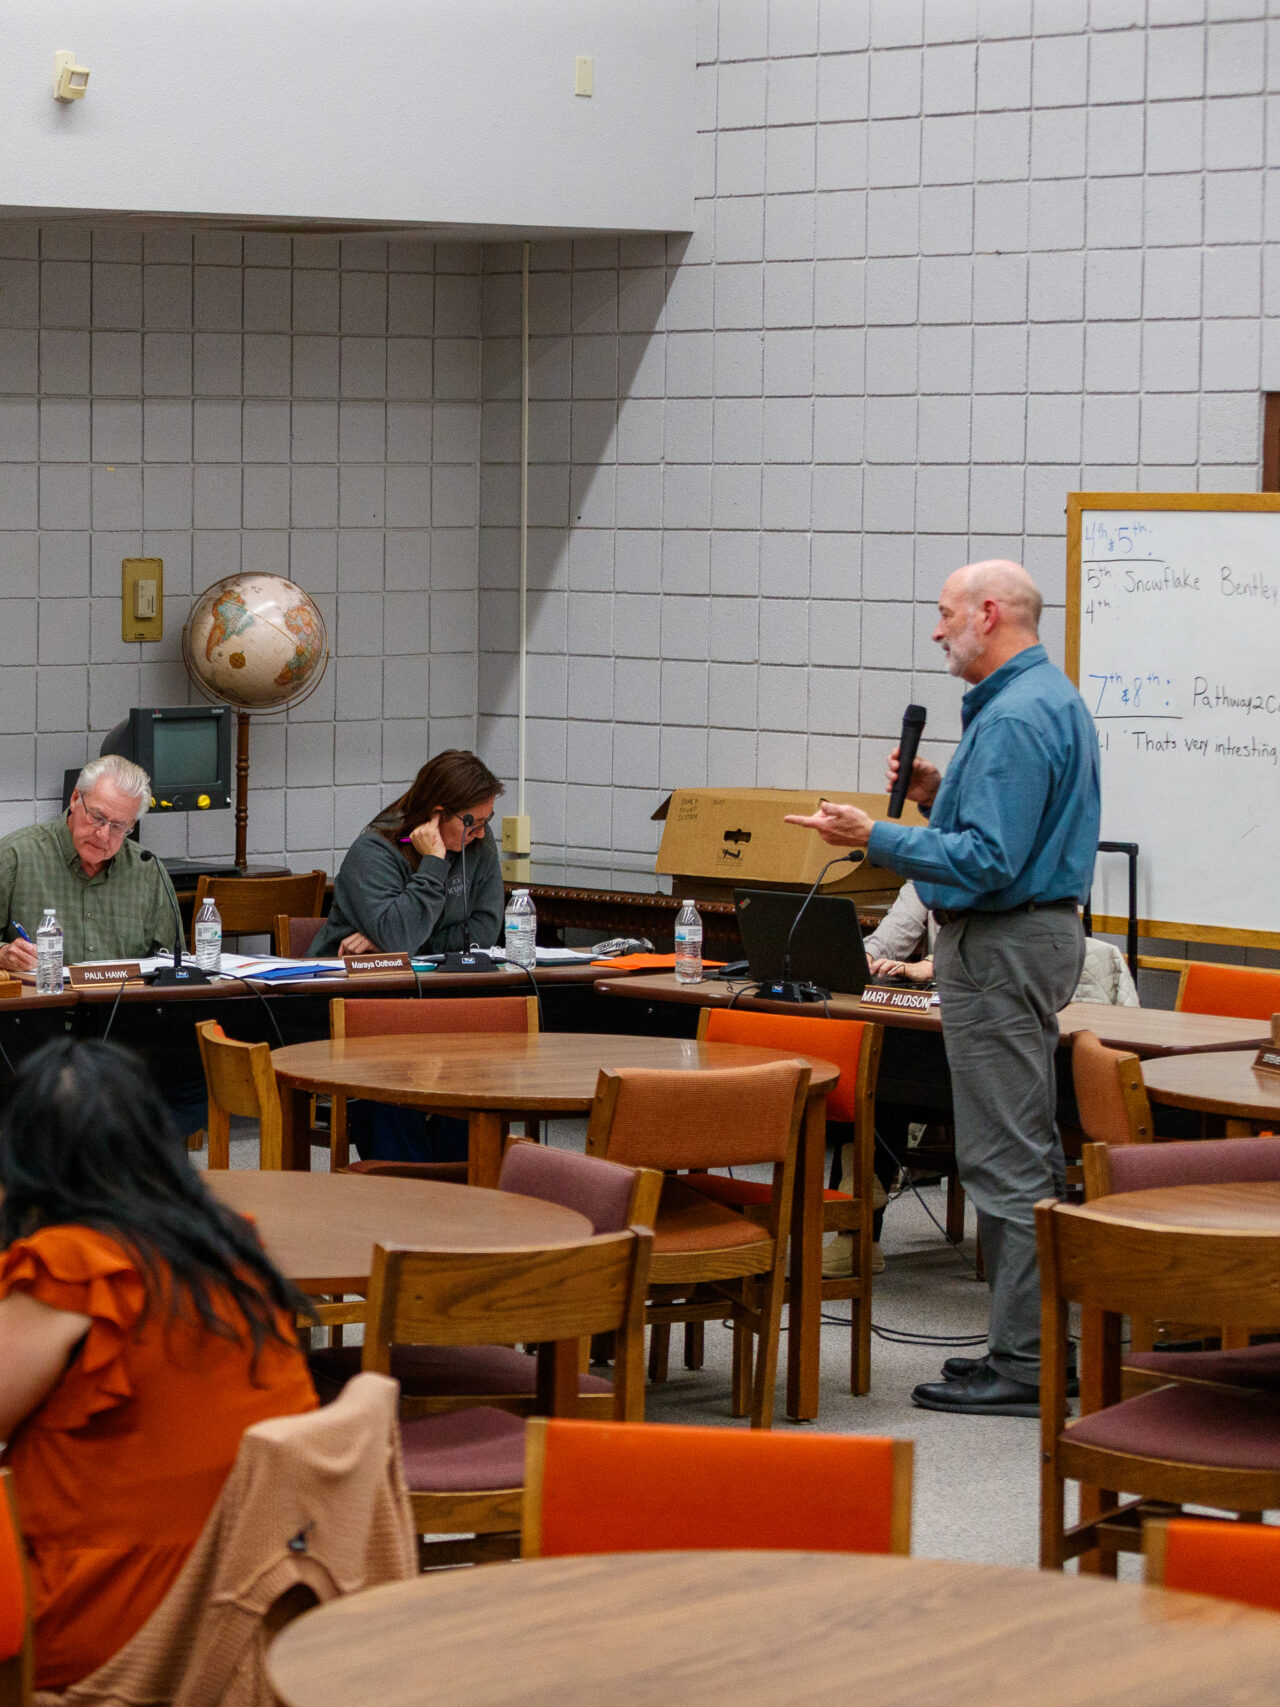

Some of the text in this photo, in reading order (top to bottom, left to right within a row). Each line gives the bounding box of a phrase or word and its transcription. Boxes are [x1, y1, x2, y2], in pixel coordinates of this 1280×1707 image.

[1124, 566, 1201, 593] Snowflake
[1220, 565, 1279, 606] Bentley
[1184, 738, 1209, 757] very
[351, 960, 375, 970] Maraya
[84, 970, 129, 981] PAUL HAWK
[861, 990, 931, 1009] MARY HUDSON
